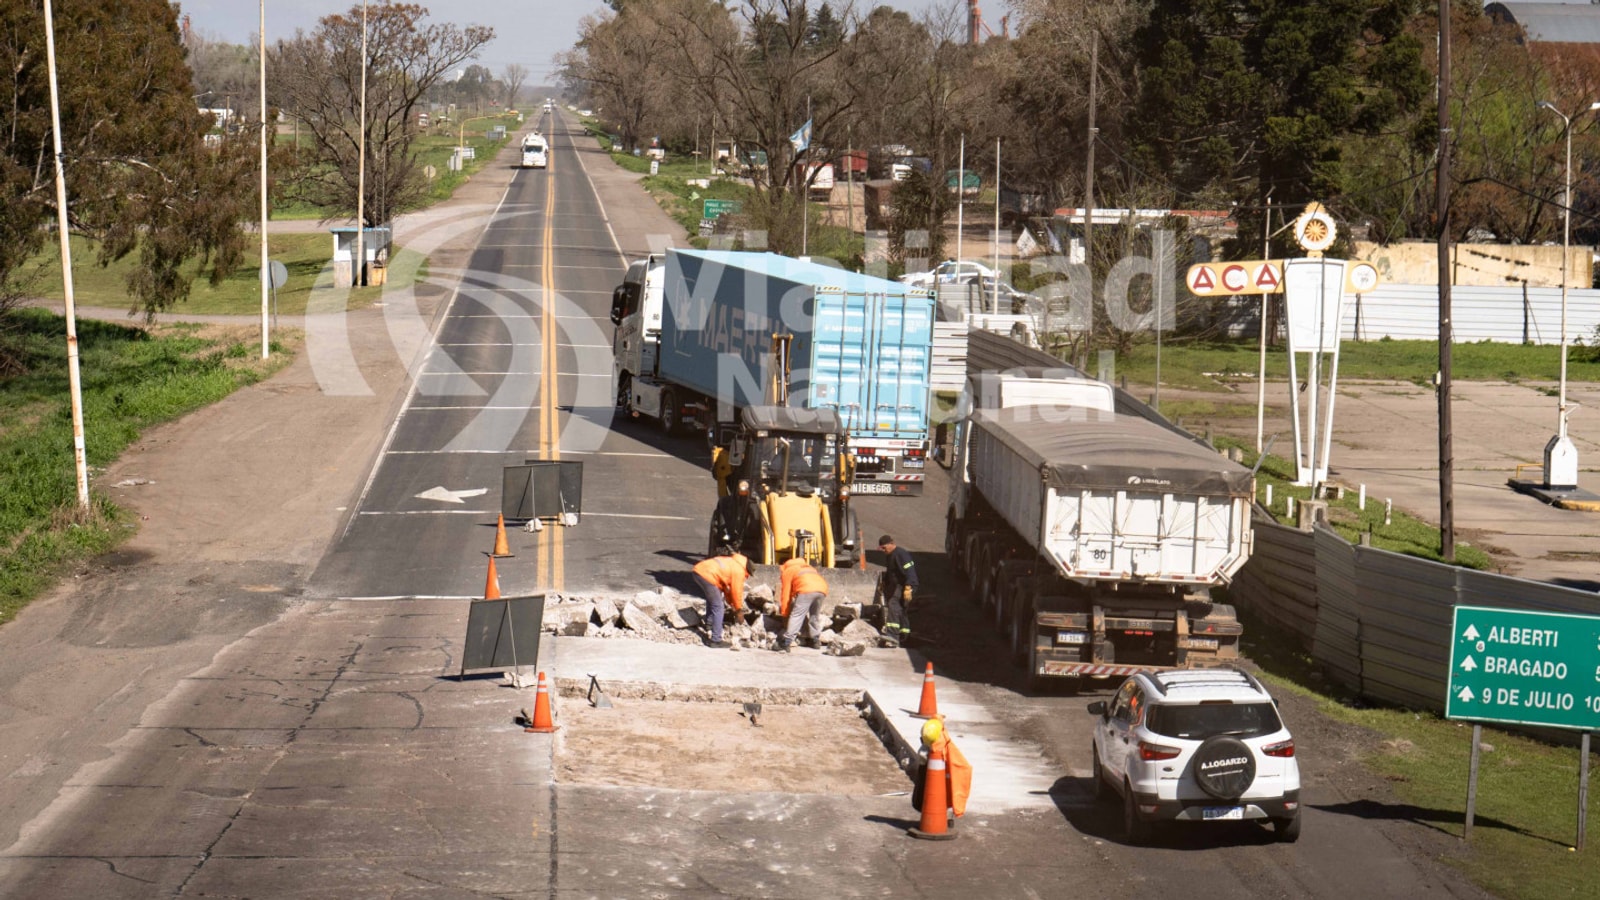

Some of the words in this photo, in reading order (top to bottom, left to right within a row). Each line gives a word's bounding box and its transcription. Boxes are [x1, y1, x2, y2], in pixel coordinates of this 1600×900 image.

[1193, 264, 1277, 291] ACA
[698, 297, 788, 366] MAERS
[1093, 549, 1107, 560] 80
[1487, 625, 1559, 648] ALBERTI
[1484, 656, 1568, 680] BRAGADO
[1482, 687, 1492, 704] 9
[1497, 688, 1520, 706] DE
[1524, 690, 1574, 710] JULIO
